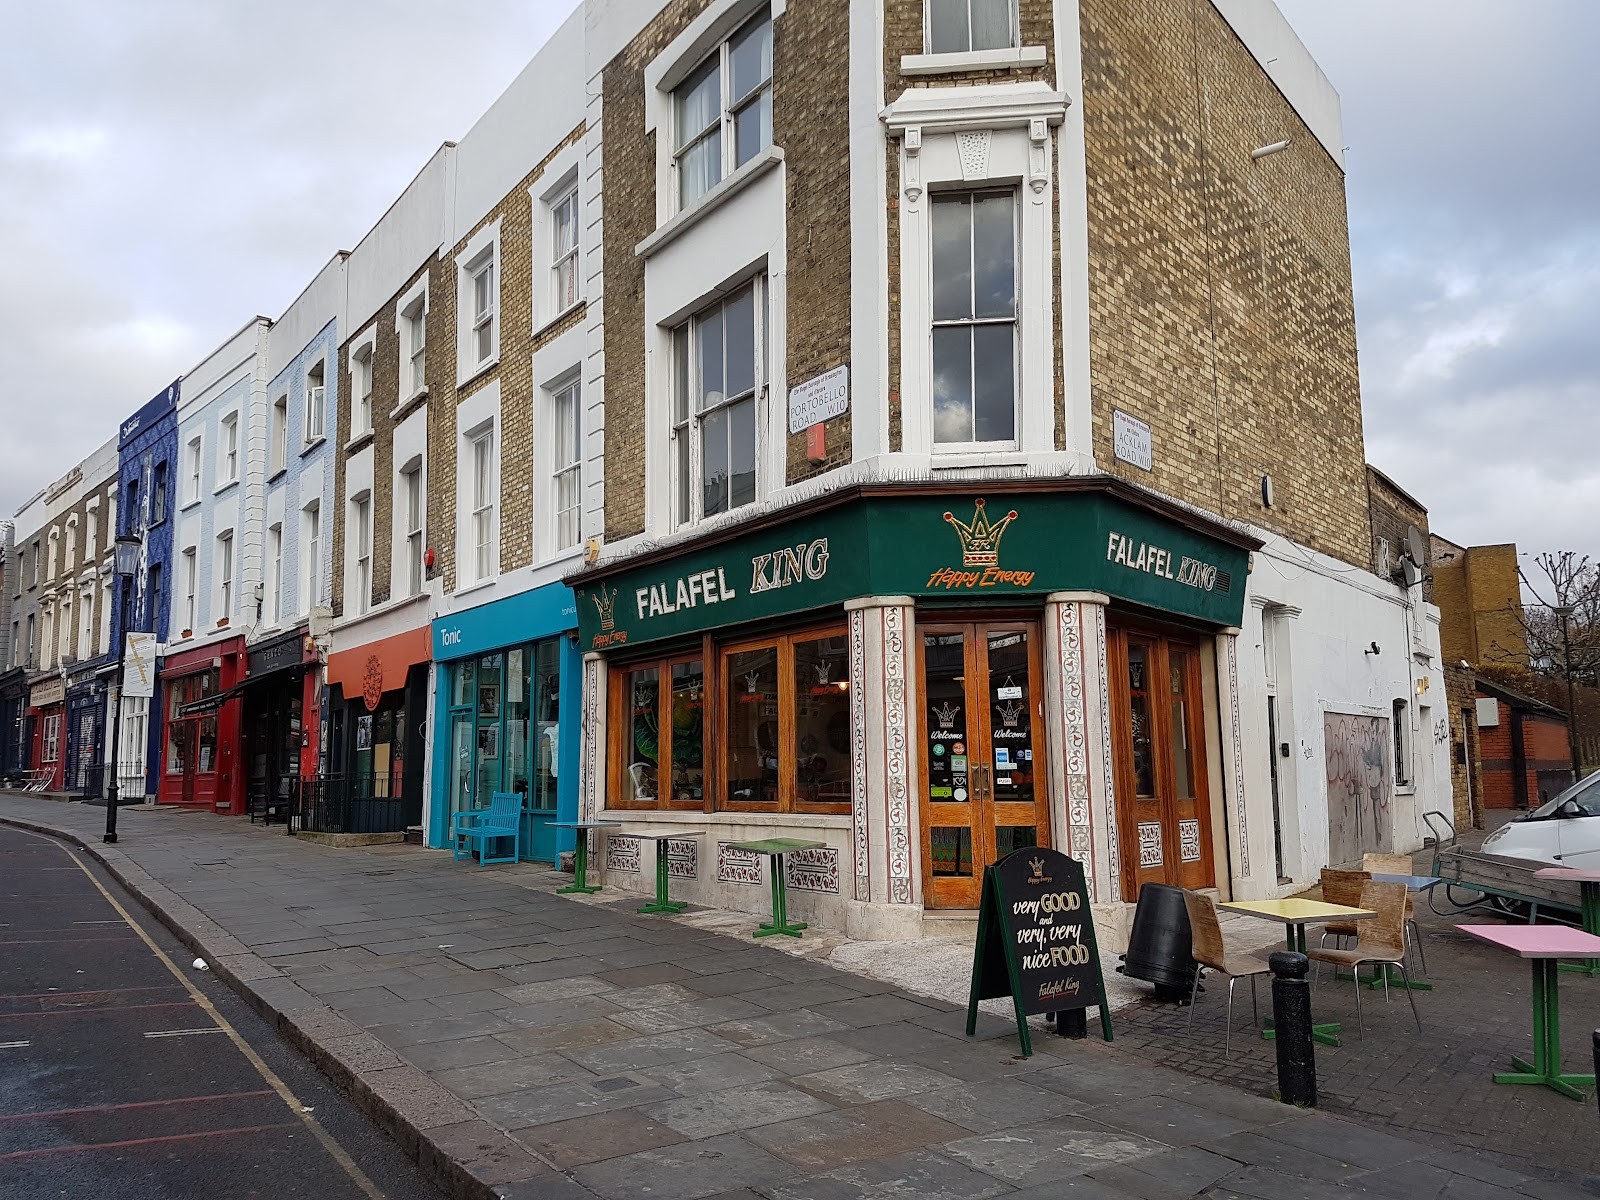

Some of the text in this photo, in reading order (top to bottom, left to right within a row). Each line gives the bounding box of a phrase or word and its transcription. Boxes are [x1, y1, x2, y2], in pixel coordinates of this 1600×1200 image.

[791, 385, 846, 418] PORTOBELLO
[1119, 432, 1148, 454] ACKLAM
[1106, 531, 1218, 592] FALAFEL KING
[635, 538, 830, 620] FALAFEL KING
[926, 566, 1037, 589] Happy Energy
[440, 626, 462, 647] Tonic
[930, 730, 963, 740] Welcome
[994, 729, 1027, 738] Welcome
[1012, 892, 1081, 922] very GOOD
[1039, 912, 1054, 926] and
[1016, 923, 1082, 950] very, very
[1022, 944, 1090, 970] nice FOOD
[1038, 976, 1080, 998] Falafel King
